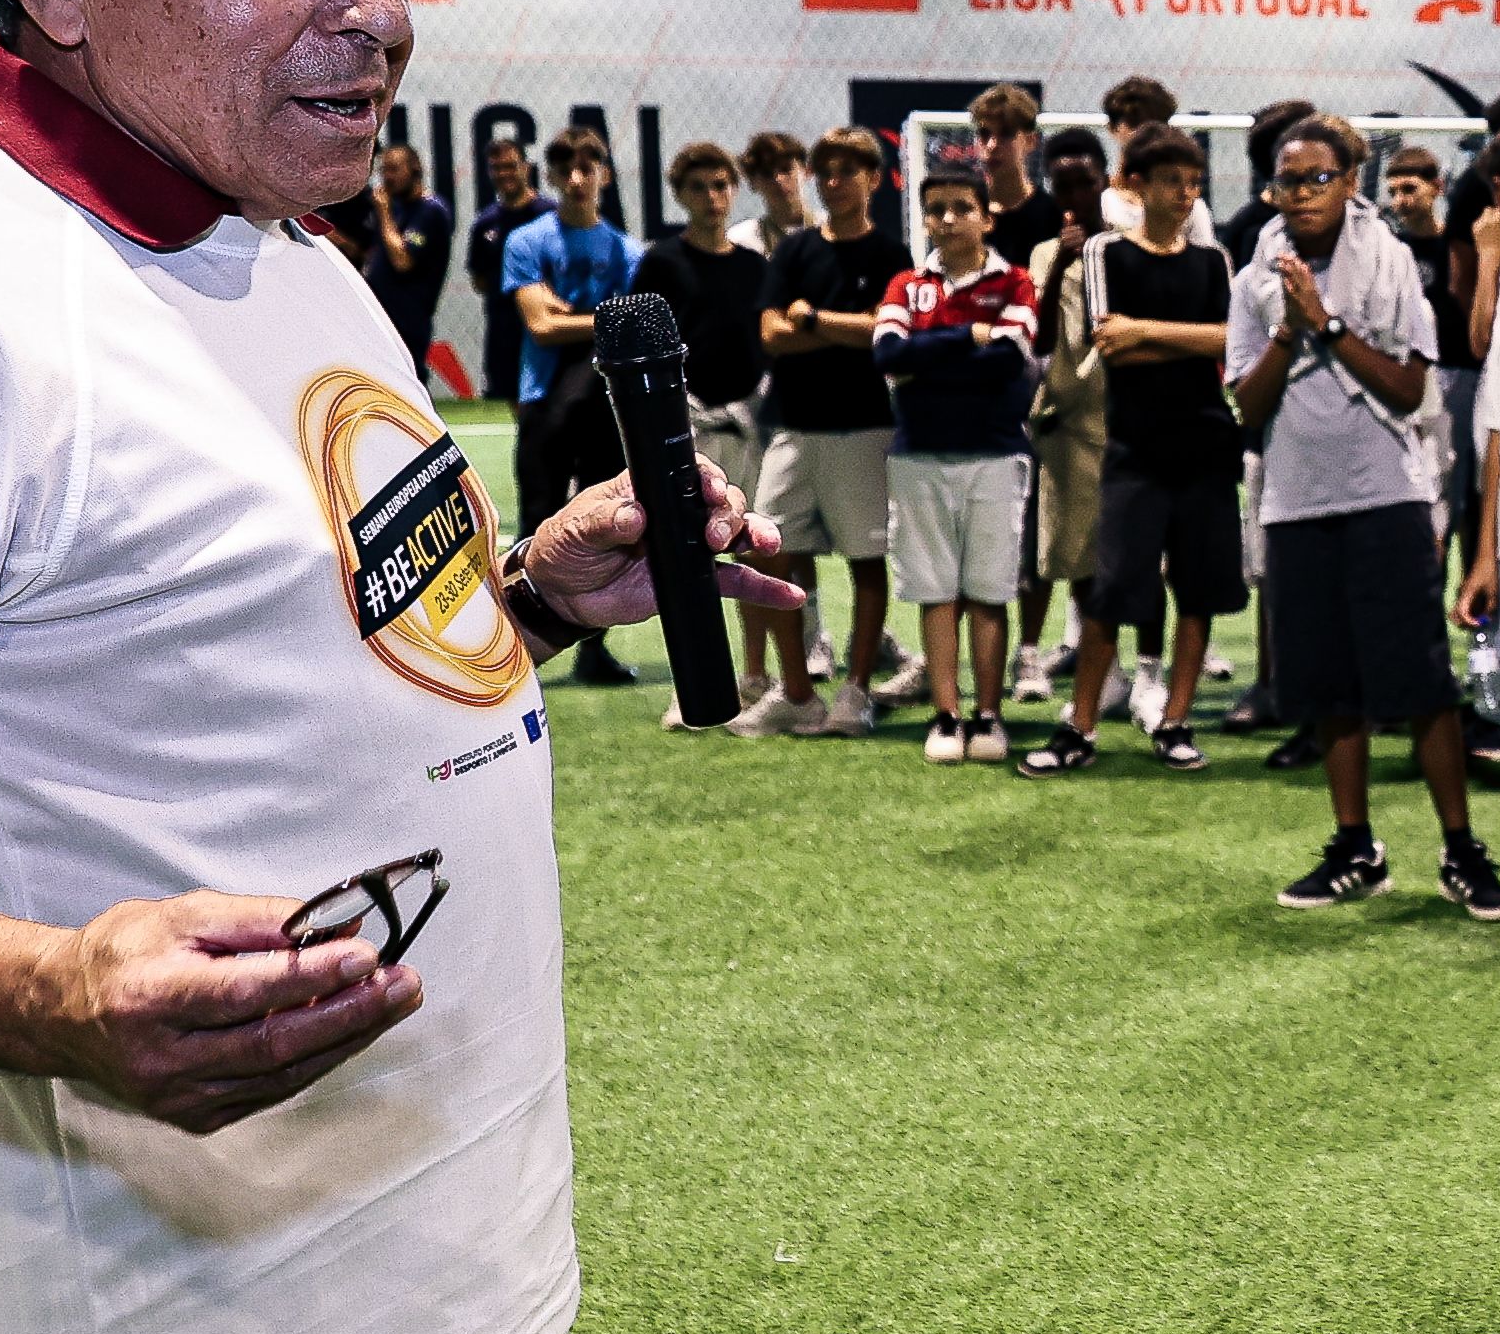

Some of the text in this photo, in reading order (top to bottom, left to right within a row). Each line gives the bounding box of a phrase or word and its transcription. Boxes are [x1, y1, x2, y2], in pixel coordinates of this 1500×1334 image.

[905, 281, 938, 313] 10
[358, 507, 390, 547] SEMANA
[386, 478, 423, 520] EUROPEIA
[416, 468, 433, 491] DO
[364, 490, 469, 618] #BEACTIVE
[433, 579, 459, 615] 23-30
